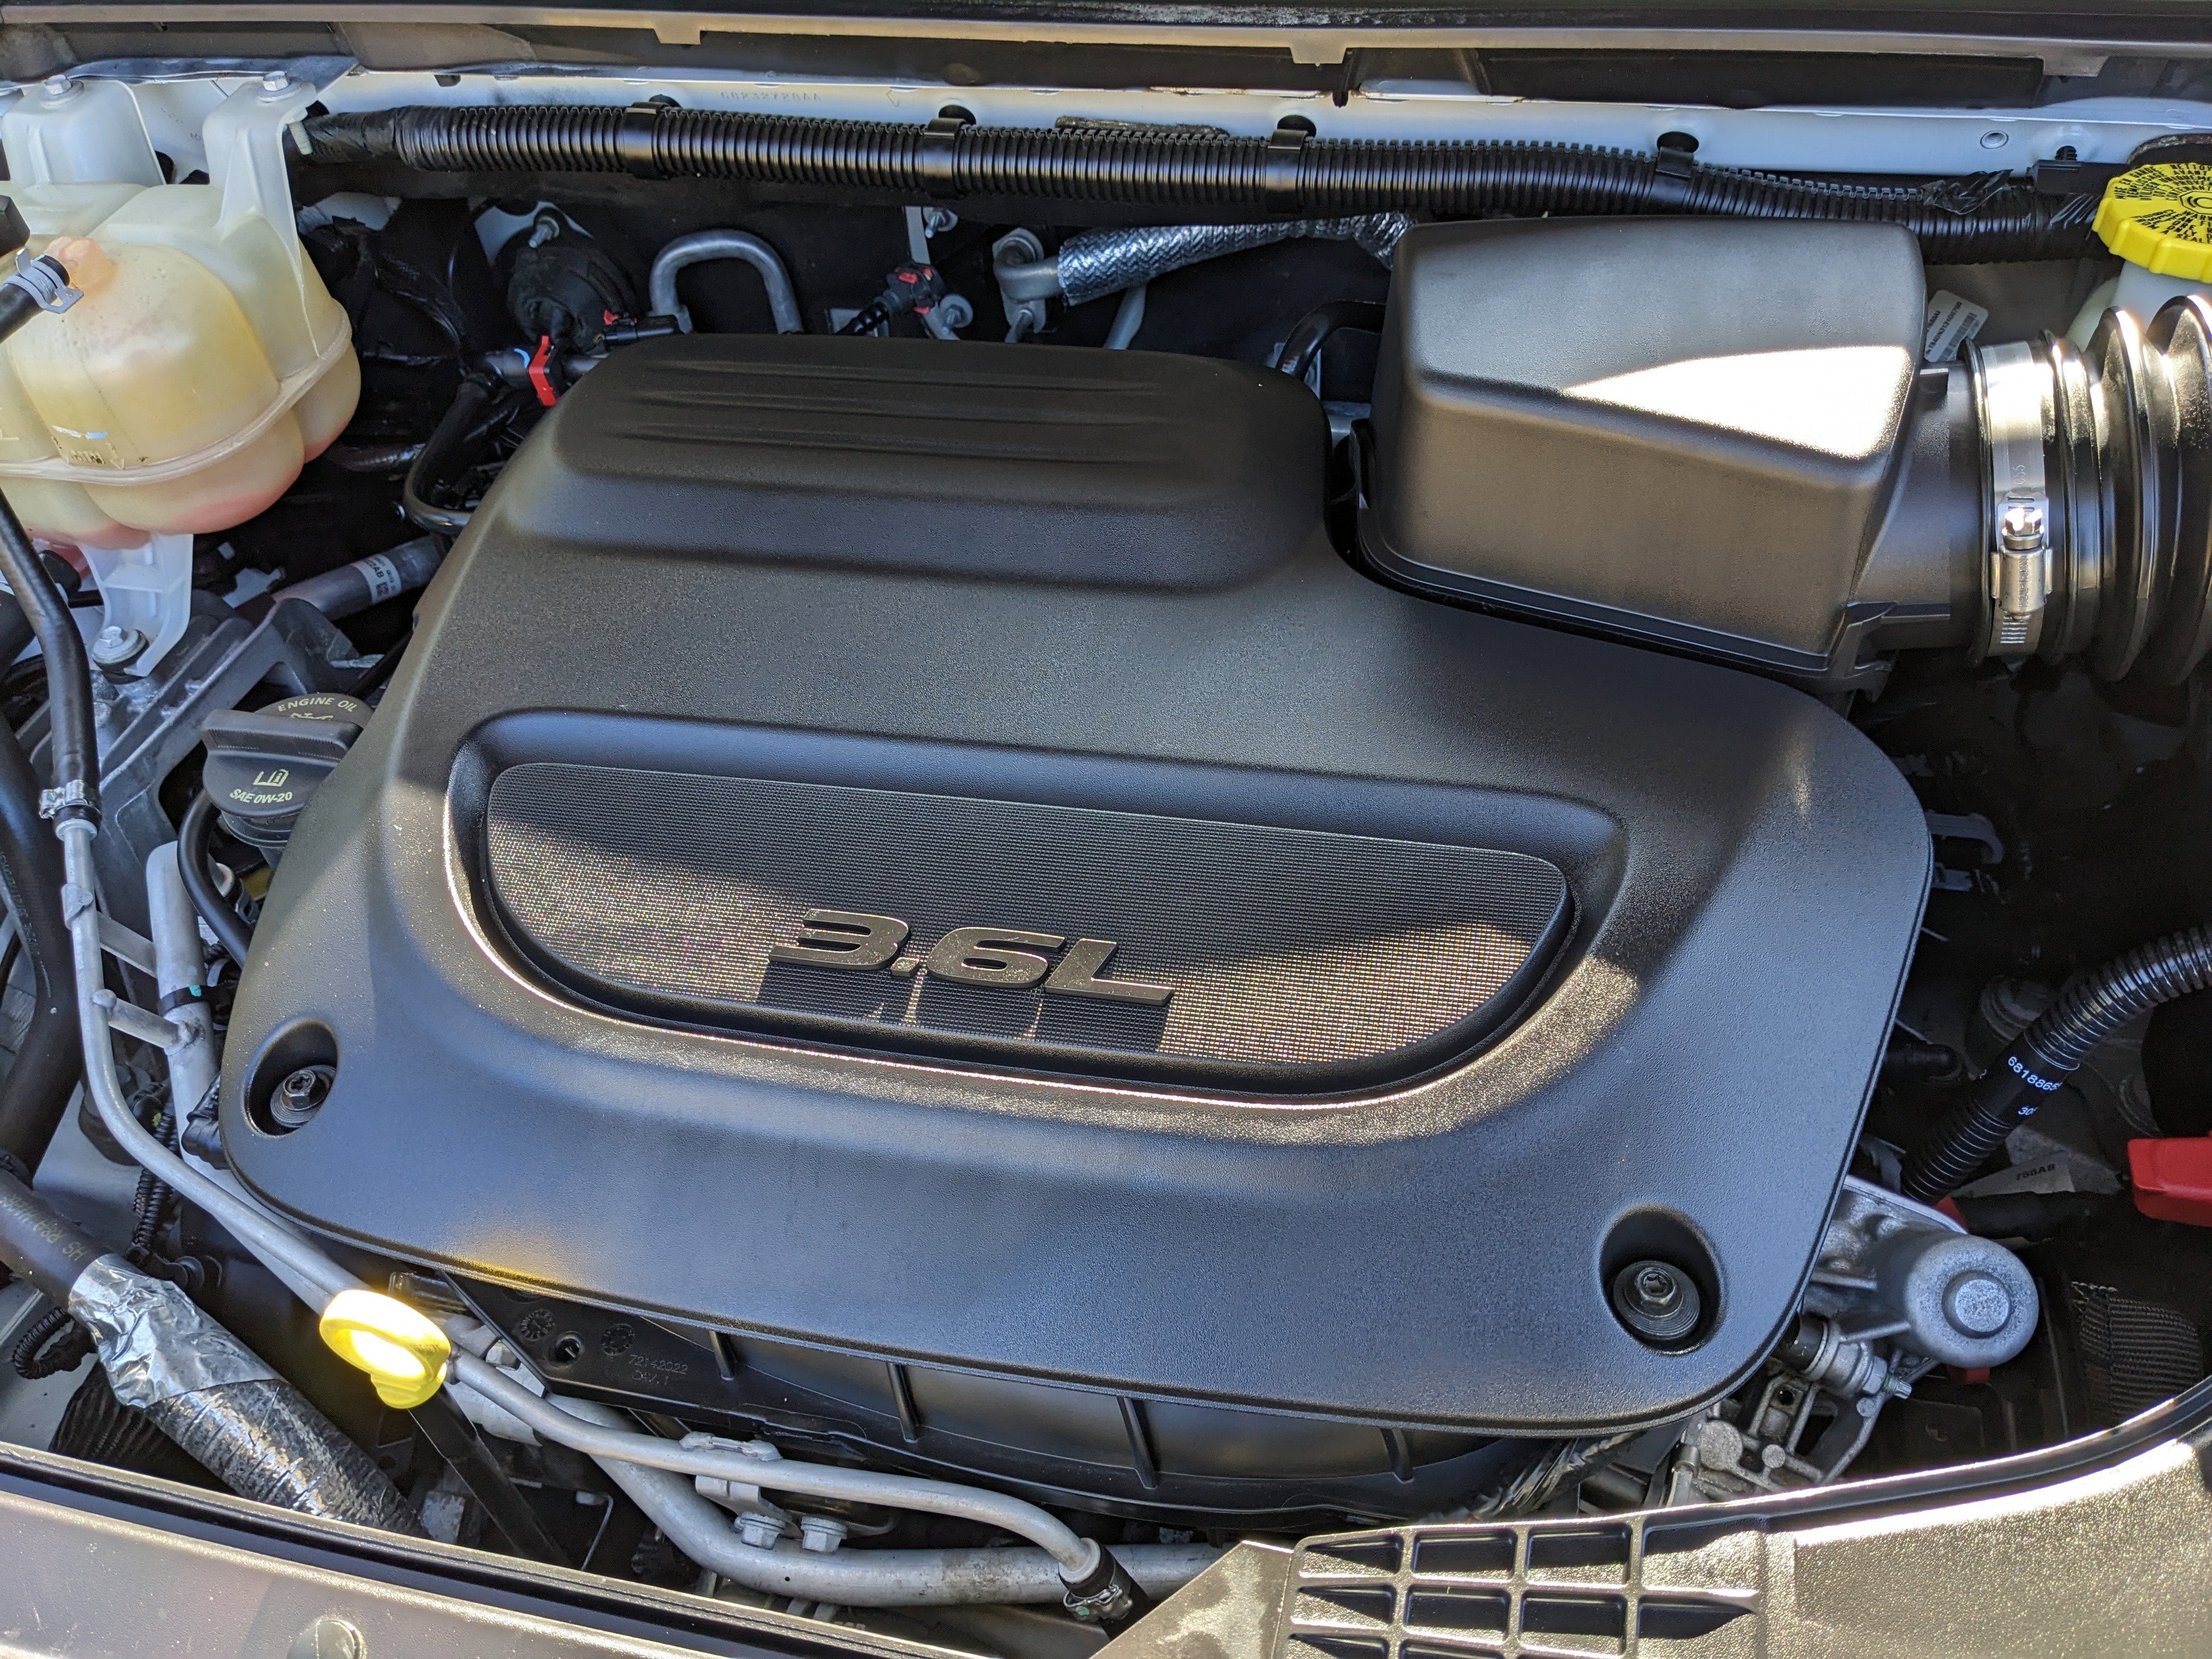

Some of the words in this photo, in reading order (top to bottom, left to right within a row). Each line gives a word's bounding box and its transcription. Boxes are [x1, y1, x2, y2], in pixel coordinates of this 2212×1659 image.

[278, 697, 335, 712] ENGINE
[337, 699, 358, 713] OIL
[230, 788, 253, 804] SAE
[253, 792, 293, 804] 0W-20
[768, 908, 1175, 1006] 3.6L
[2008, 1056, 2062, 1091] 6818865
